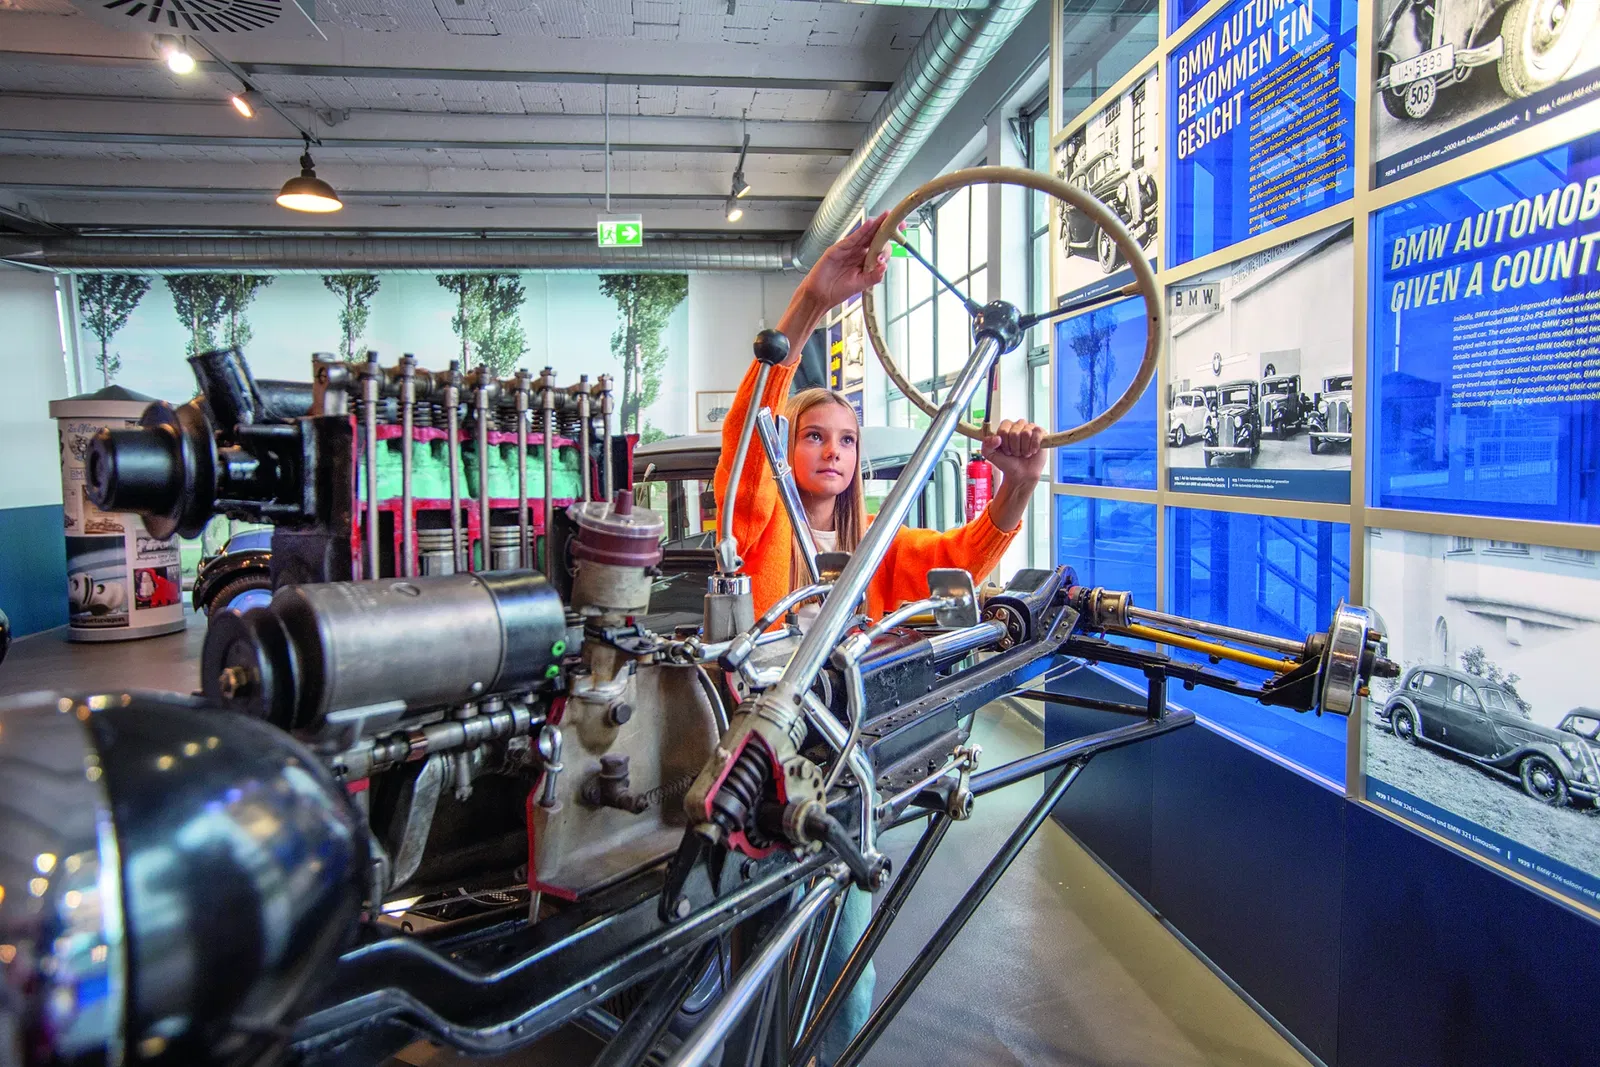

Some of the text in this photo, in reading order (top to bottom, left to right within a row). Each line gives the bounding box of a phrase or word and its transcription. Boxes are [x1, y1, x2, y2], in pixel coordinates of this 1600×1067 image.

[1178, 0, 1294, 88] BMW AUTO
[1178, 0, 1314, 124] BEKOMMEN EIN
[1410, 84, 1430, 106] 503
[1178, 89, 1245, 160] GESICHT
[1390, 174, 1600, 271] BMW AUTOMOB
[1390, 231, 1600, 313] GIVEN A COUNT
[1176, 288, 1213, 306] BMW
[1474, 309, 1490, 318] BMW
[1519, 298, 1549, 312] improved
[1550, 296, 1561, 305] the
[1561, 292, 1584, 303] Austin
[1502, 314, 1519, 324] BMW
[1557, 305, 1573, 315] bore
[1530, 321, 1540, 329] the
[1541, 318, 1560, 328] BMW
[1560, 316, 1573, 326] 303
[1574, 315, 1588, 323] was
[1504, 334, 1524, 345] design
[1525, 332, 1538, 341] and
[1538, 330, 1551, 339] this
[1551, 327, 1573, 338] model
[1573, 325, 1588, 334] had
[1534, 340, 1553, 350] BMW
[1575, 336, 1588, 345] the
[1530, 364, 1542, 372] but
[1542, 360, 1572, 372] provided
[1522, 385, 1544, 394] people
[1545, 383, 1568, 393] driving
[1569, 381, 1585, 390] their
[1523, 395, 1556, 404] reputation
[1412, 807, 1436, 823] Limousine
[1436, 818, 1446, 828] und
[1446, 822, 1460, 834] BMW
[1461, 829, 1472, 840] 321
[1472, 834, 1500, 854] Limousine
[1536, 865, 1551, 878] BMW
[1563, 878, 1583, 891] saloon
[1583, 887, 1596, 899] and
